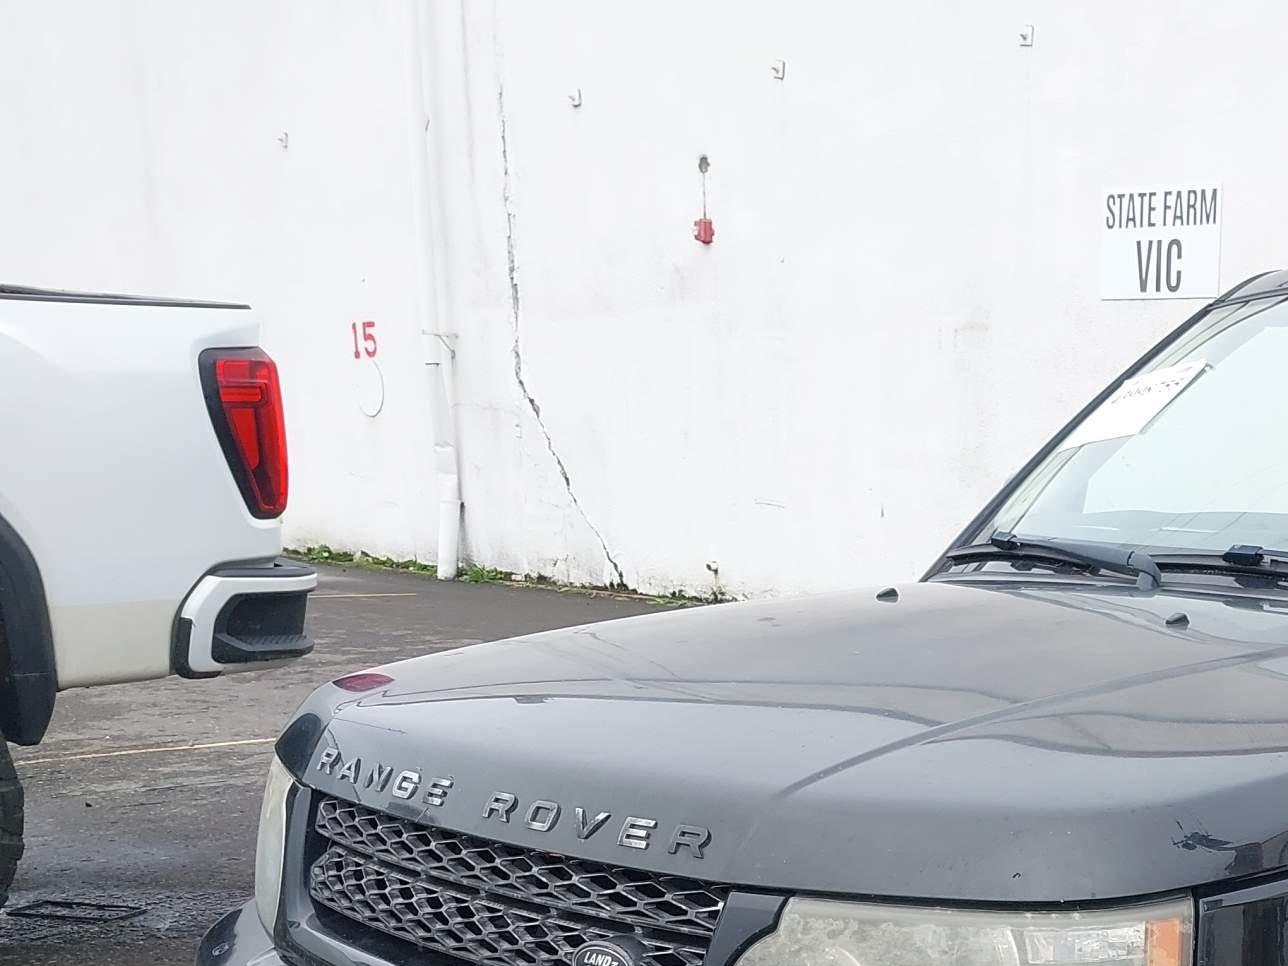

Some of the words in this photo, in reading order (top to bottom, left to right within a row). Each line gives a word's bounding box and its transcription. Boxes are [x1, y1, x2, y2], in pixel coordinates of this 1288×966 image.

[1106, 191, 1157, 229] STATE
[1163, 187, 1218, 227] FARM
[1136, 238, 1183, 293] VIC
[351, 321, 377, 359] 15
[316, 747, 455, 807] RANGE
[482, 791, 712, 859] ROVER
